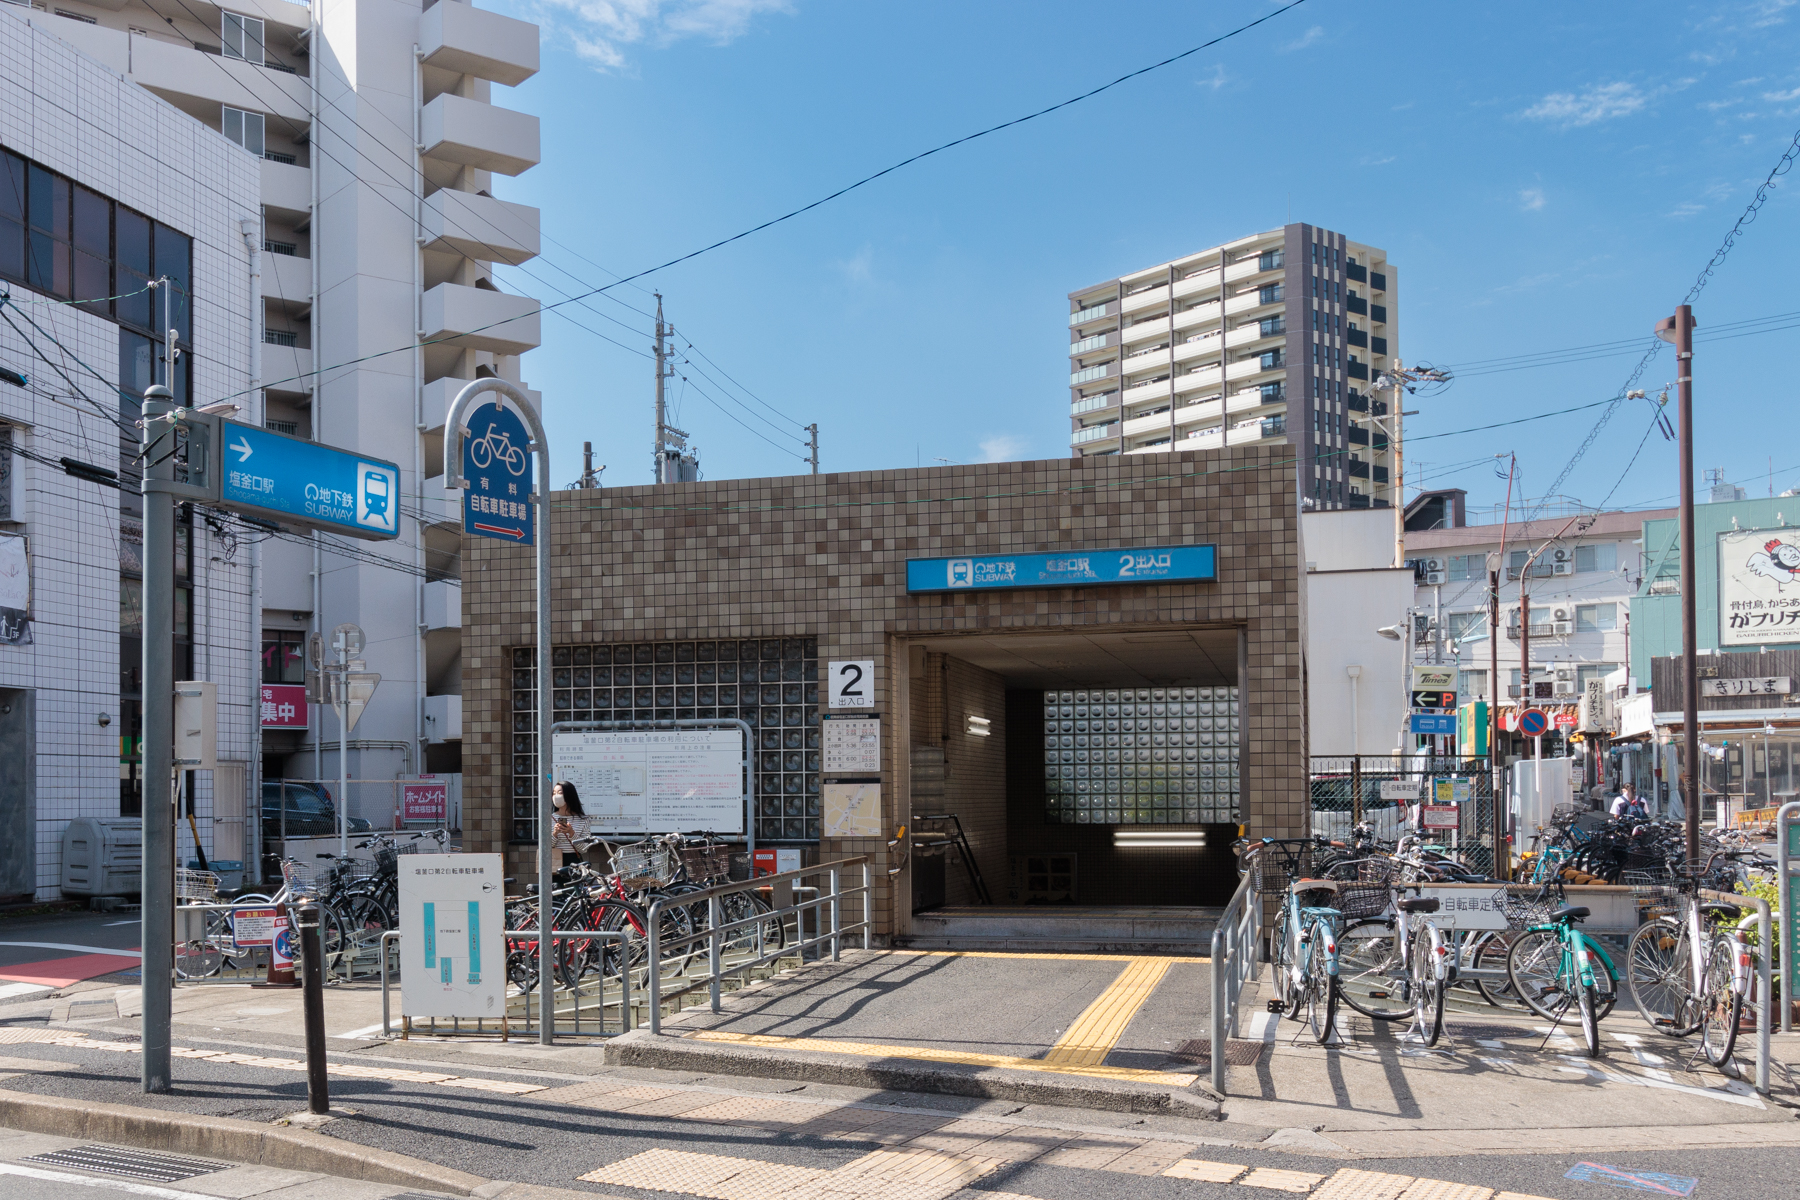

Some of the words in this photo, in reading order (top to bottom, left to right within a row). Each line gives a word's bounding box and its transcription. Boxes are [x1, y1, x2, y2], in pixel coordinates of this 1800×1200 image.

[229, 470, 275, 494] 塩釜口駅
[319, 487, 354, 509] 地下鉄
[304, 501, 354, 522] SUBWAY
[471, 494, 527, 521] 自転車駐車場
[986, 562, 1016, 573] 地下鉄
[1046, 557, 1090, 572] 塩釜口駅
[1119, 555, 1135, 576] 2
[1136, 554, 1171, 568] 出入口
[975, 572, 1016, 583] SUBWAY
[840, 664, 863, 696] 2
[1420, 673, 1449, 684] Times
[1716, 679, 1777, 695] きりしま
[838, 697, 865, 706] 出入口
[1442, 692, 1454, 707] P
[262, 702, 295, 722] 集中
[405, 790, 445, 803] ホームメイト
[415, 868, 485, 876] 塩釜口第2自転車駐車場
